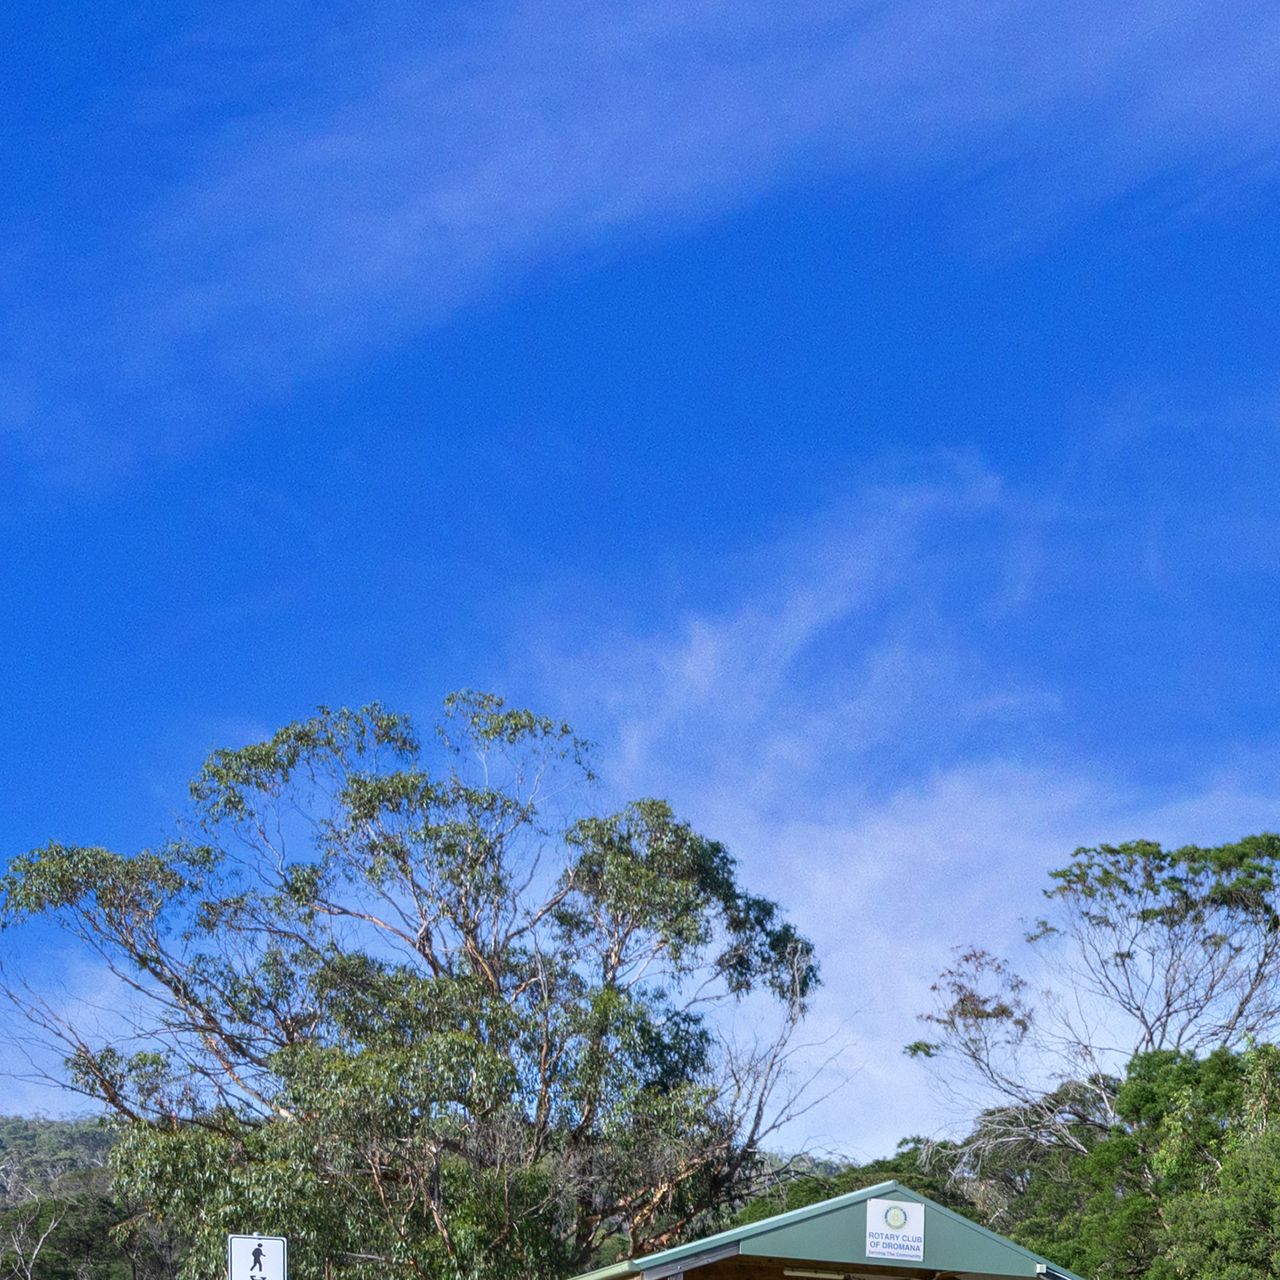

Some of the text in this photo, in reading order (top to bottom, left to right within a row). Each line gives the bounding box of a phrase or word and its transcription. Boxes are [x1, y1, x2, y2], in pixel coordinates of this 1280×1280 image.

[868, 1232, 922, 1243] ROTARY CLUB
[882, 1242, 921, 1251] DROMANA
